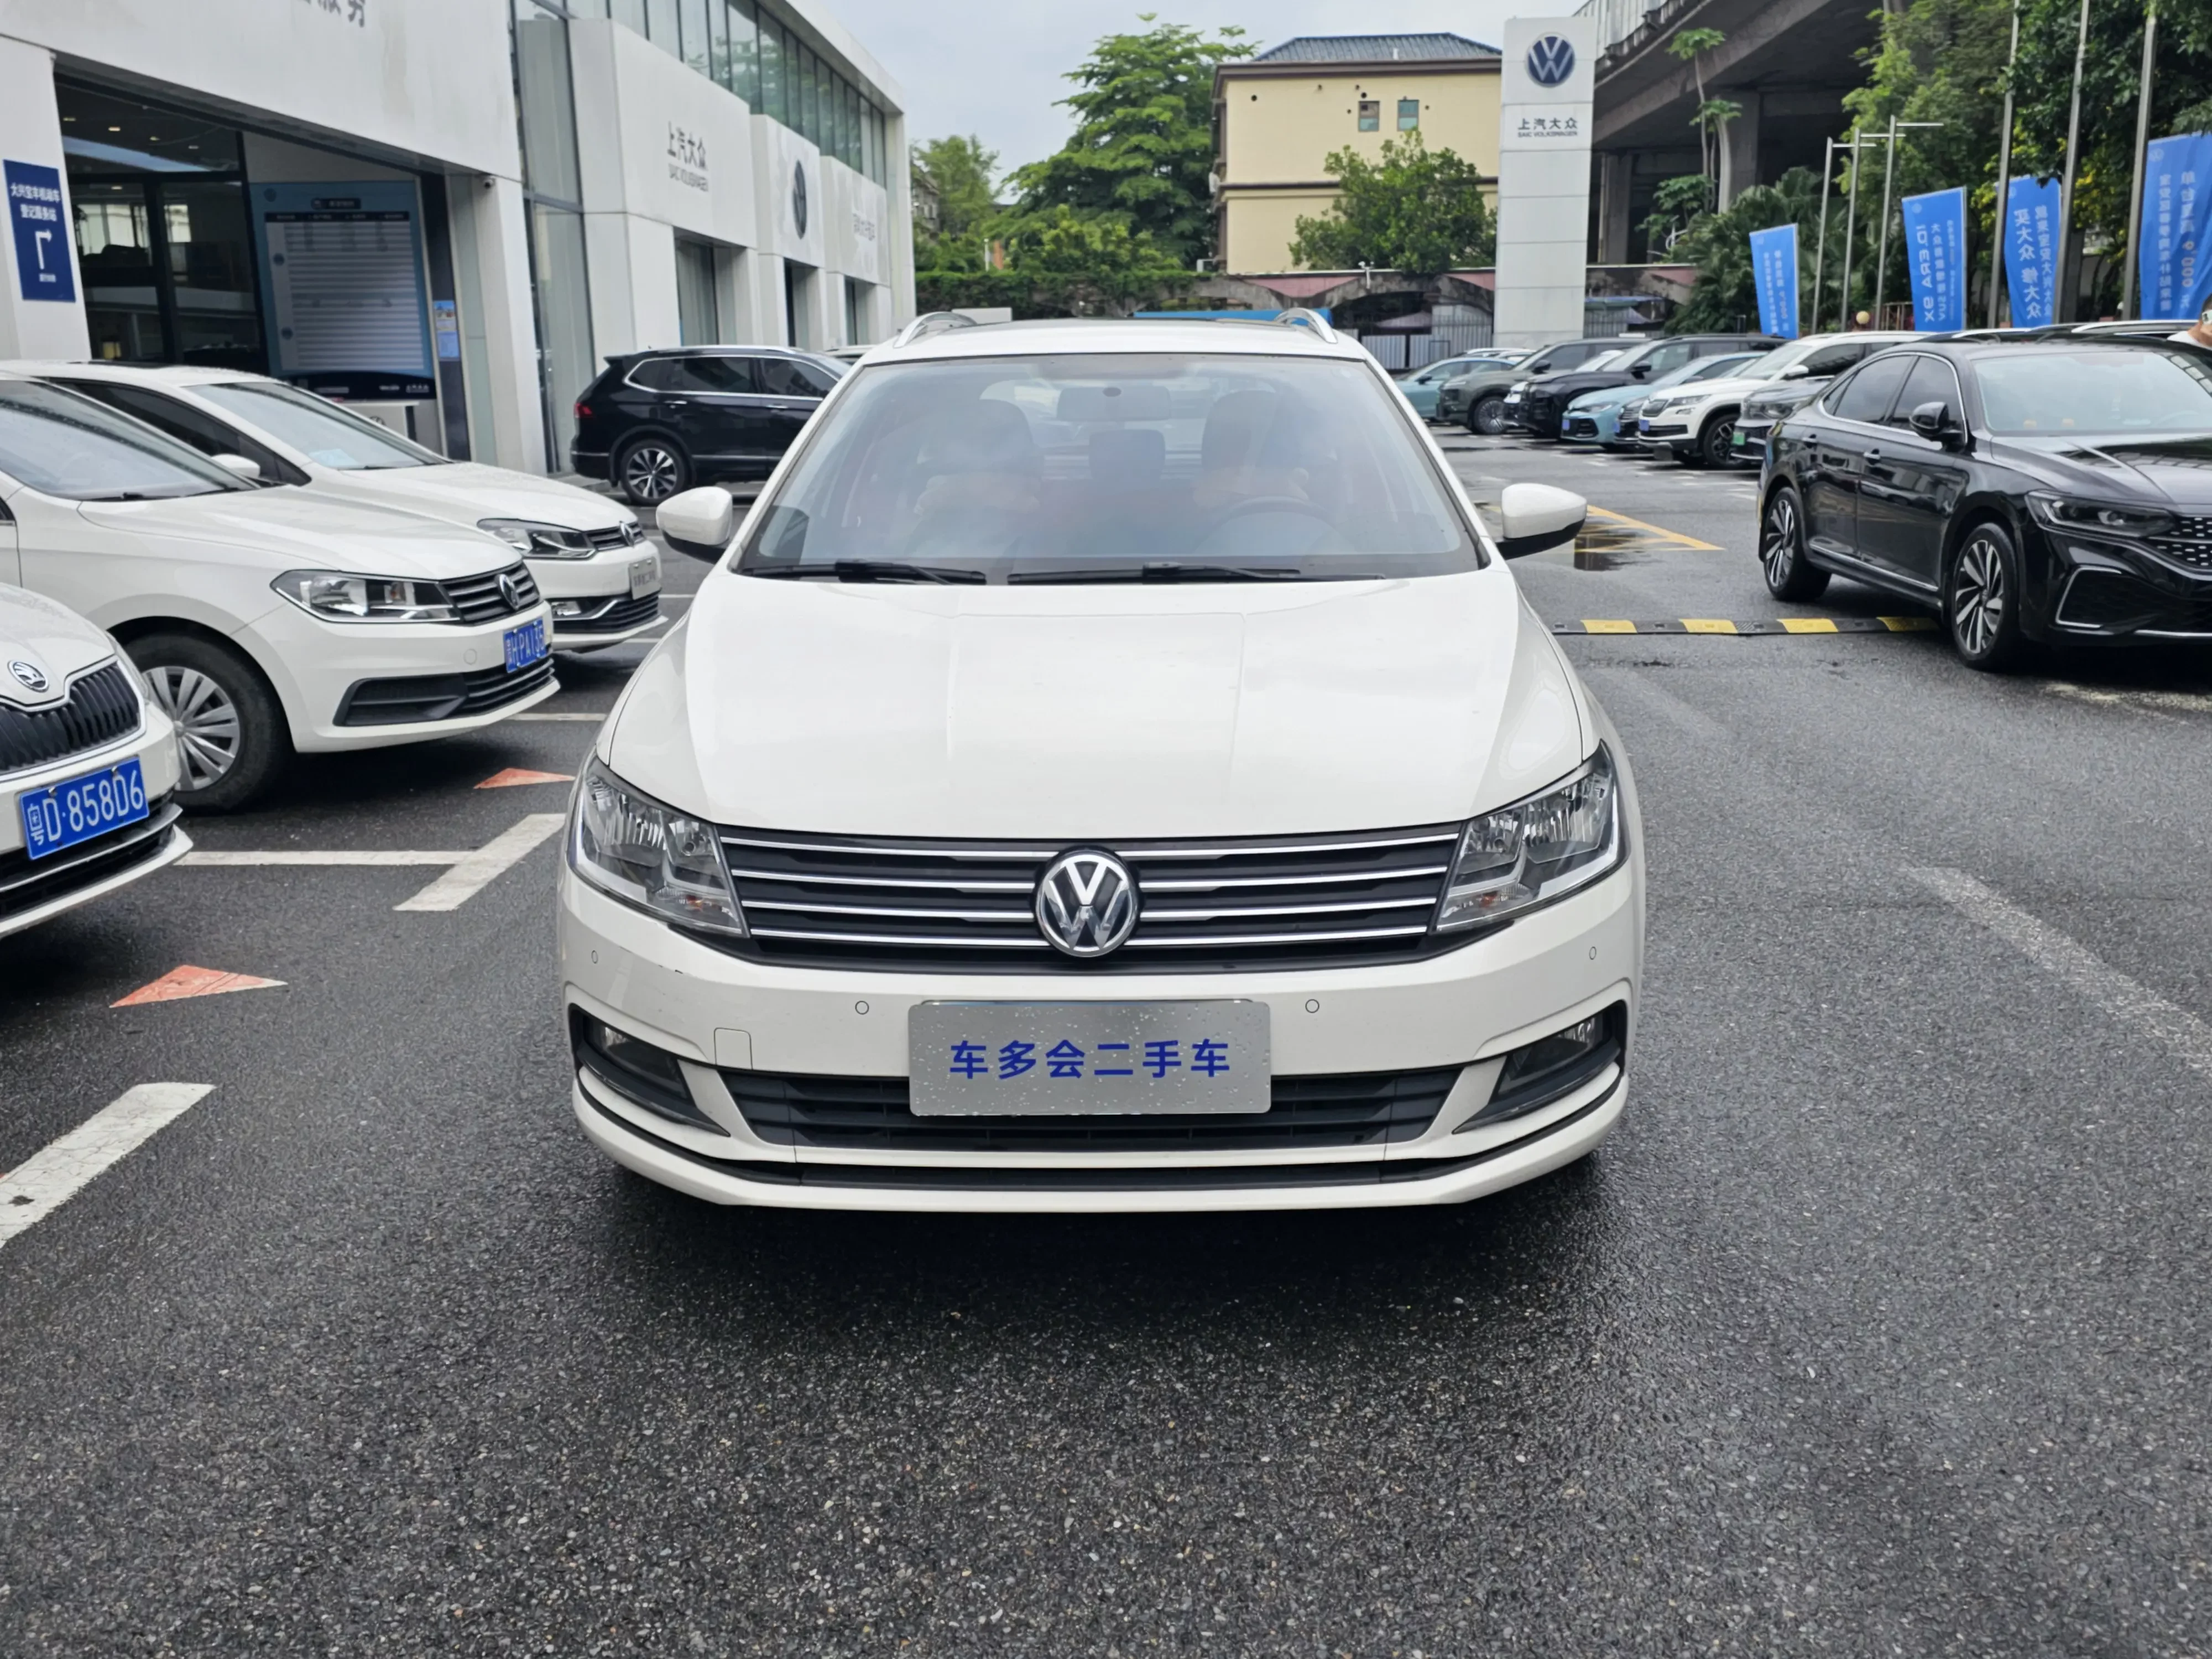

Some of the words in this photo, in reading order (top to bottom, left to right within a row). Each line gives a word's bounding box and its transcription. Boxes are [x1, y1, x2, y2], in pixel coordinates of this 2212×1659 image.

[1517, 117, 1579, 131] 上汽大众
[1037, 852, 1137, 957] VW
[950, 1039, 1230, 1080] 车多会二手车
